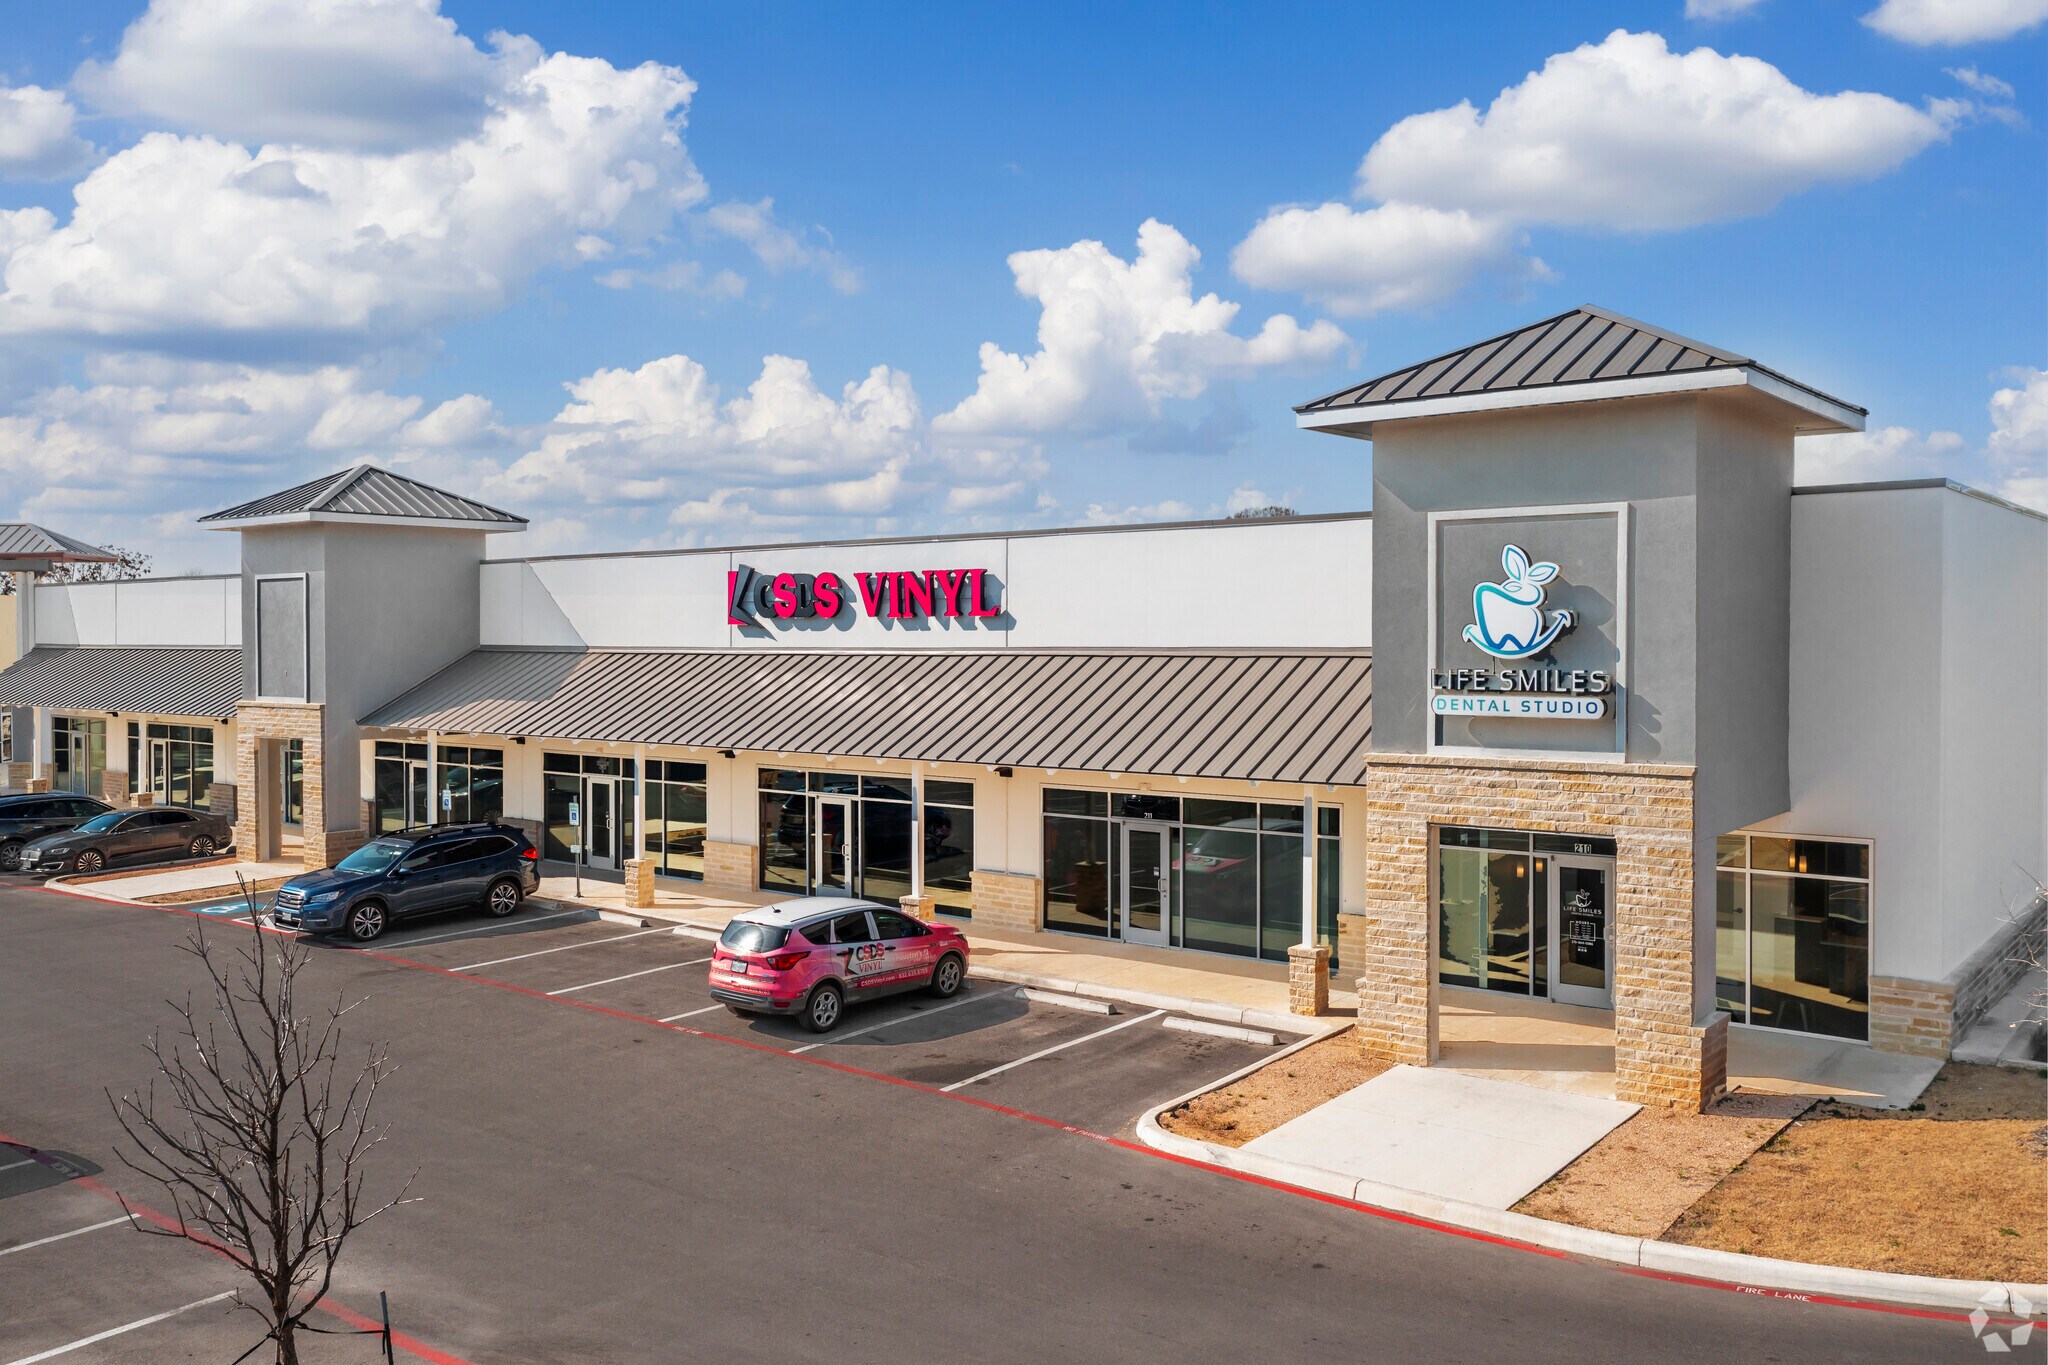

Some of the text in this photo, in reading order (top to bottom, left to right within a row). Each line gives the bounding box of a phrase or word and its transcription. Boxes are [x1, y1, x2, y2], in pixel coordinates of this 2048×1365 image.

[753, 568, 1000, 618] CSDS VINYL
[1431, 668, 1607, 692] LIFE SMILES
[1436, 698, 1599, 715] DENTAL STUDIO
[1575, 843, 1592, 854] 210
[1578, 907, 1602, 915] SMILES
[856, 942, 885, 962] CSDS
[859, 960, 882, 973] VINYL
[1736, 1285, 1812, 1302] FIRE LANE
